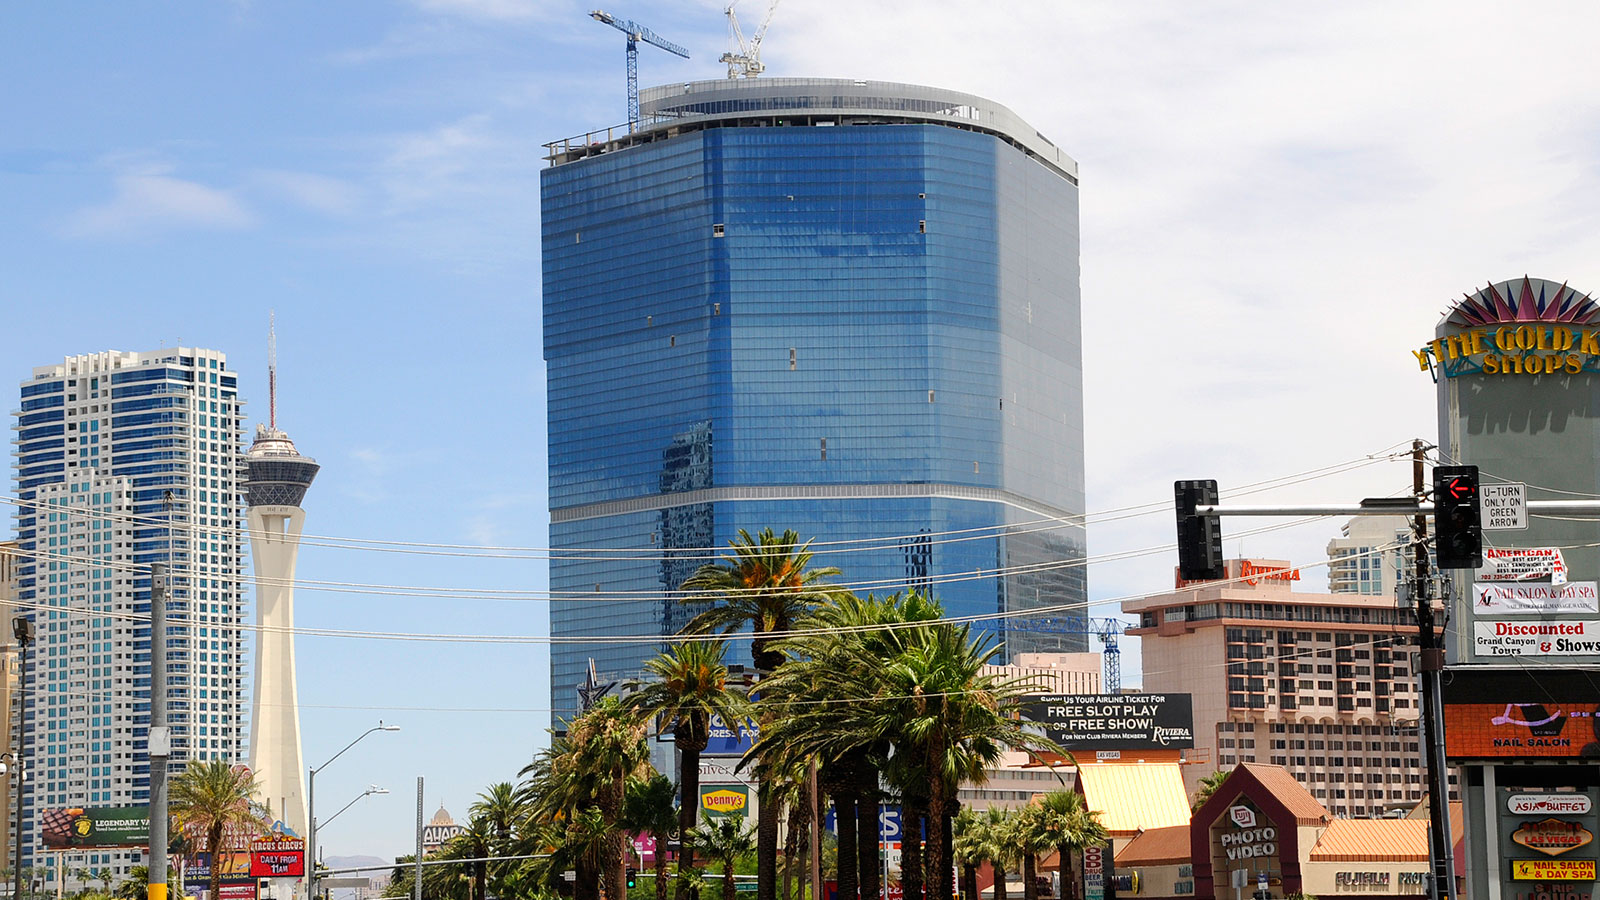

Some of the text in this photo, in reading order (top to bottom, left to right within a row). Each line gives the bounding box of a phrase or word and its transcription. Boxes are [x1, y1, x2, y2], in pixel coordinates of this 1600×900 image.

[1427, 328, 1489, 363] THE
[1495, 325, 1573, 351] GOLD
[1482, 353, 1583, 375] SHOPS
[1483, 487, 1520, 497] U-TURN
[1484, 498, 1521, 507] ONLY ON
[1490, 508, 1517, 517] GREEN
[1489, 518, 1518, 527] ARROW
[1487, 549, 1552, 558] AMERICAN
[1240, 560, 1300, 586] RIVIERA
[1494, 588, 1516, 599] NAIL
[1518, 588, 1548, 599] SALON
[1549, 590, 1557, 599] &
[1560, 587, 1577, 599] DAY
[1579, 587, 1595, 598] SPA
[1495, 622, 1584, 636] Discounted
[1477, 637, 1536, 648] Grand Canyon
[1540, 638, 1600, 652] & Shows
[1491, 646, 1522, 655] Tours
[1047, 705, 1158, 717] FREE SLOT PLAY
[1069, 719, 1105, 730] FREE
[1108, 718, 1153, 730] SHOW!
[1152, 726, 1190, 746] RIVIERA
[1493, 738, 1571, 747] NAIL SALON
[706, 795, 743, 807] Denny's
[1515, 802, 1586, 812] ASIA BUFFET
[95, 819, 140, 827] LEGENDARY
[1221, 827, 1275, 847] PHOTO
[277, 841, 304, 850] CIRCUS
[1226, 843, 1275, 861] VIDEO
[260, 854, 298, 864] DAILY FROM
[271, 864, 289, 873] 11AM
[1533, 861, 1594, 870] NAIL SALON
[1335, 872, 1425, 886] FUJIFILM PHOT
[1534, 870, 1594, 878] & DAY SPA
[1535, 884, 1575, 893] STRIP
